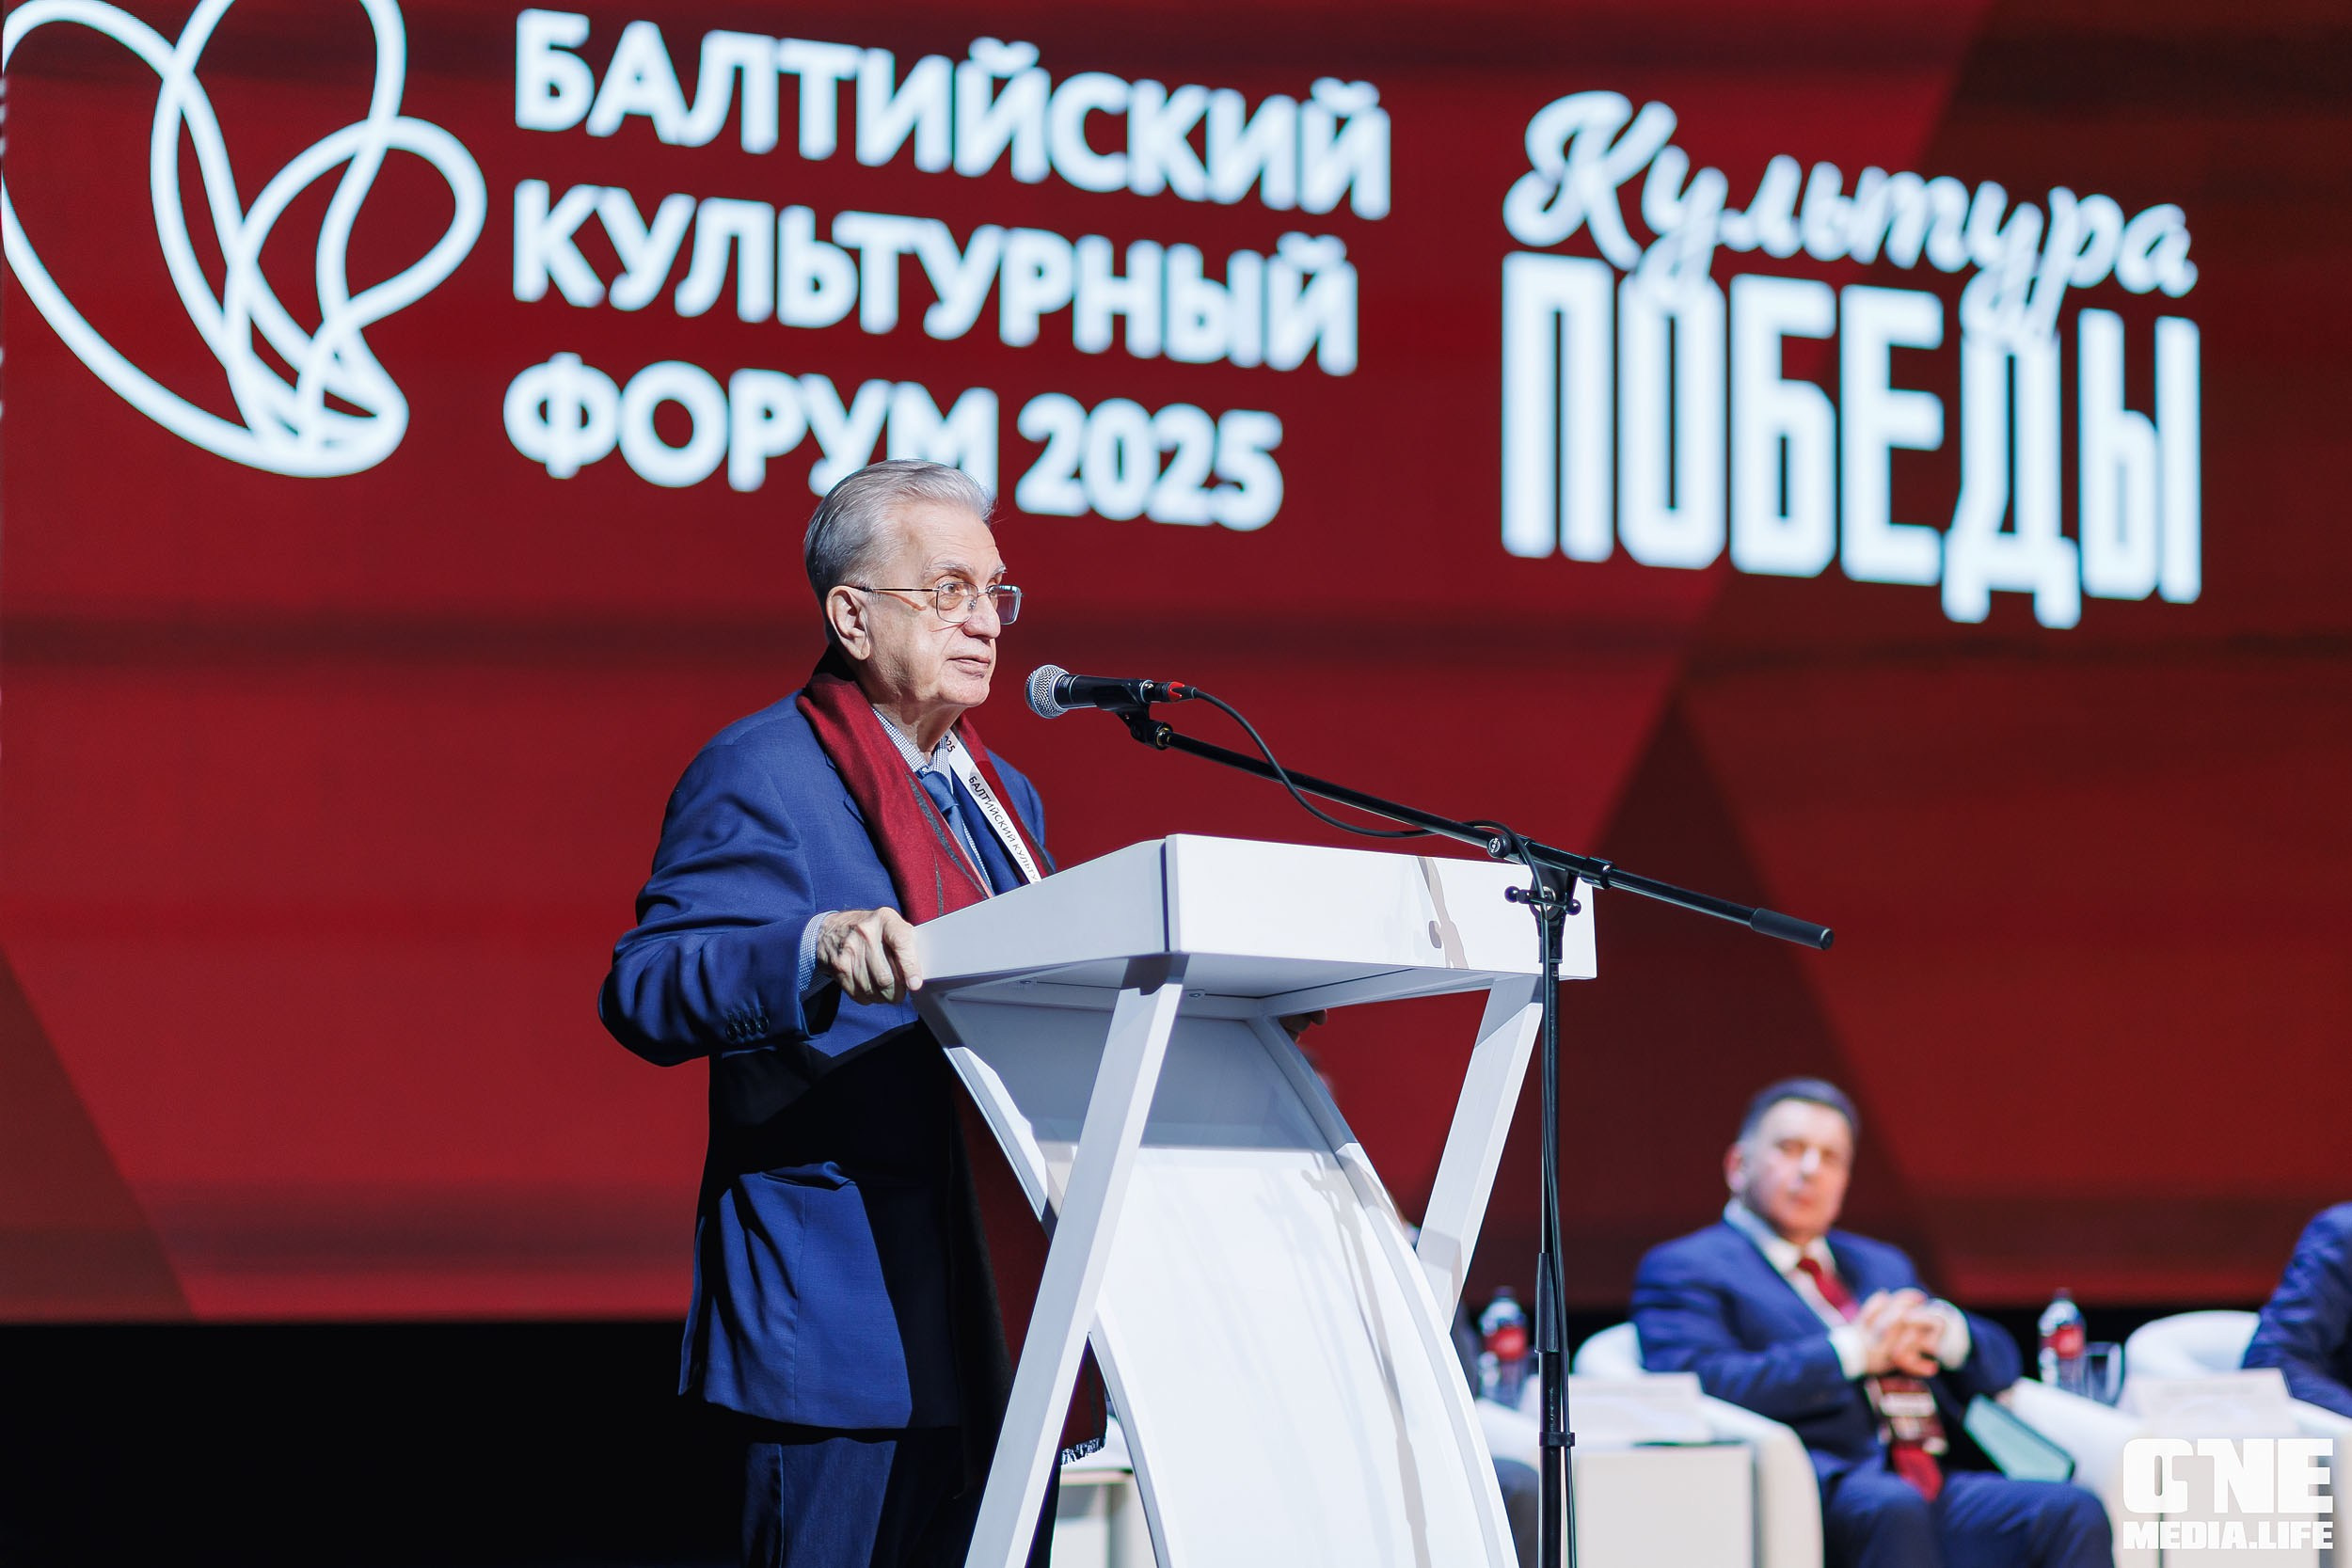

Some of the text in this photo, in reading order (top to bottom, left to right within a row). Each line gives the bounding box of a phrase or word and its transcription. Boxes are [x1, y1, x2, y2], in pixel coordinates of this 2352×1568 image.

[515, 8, 1391, 220] БАЛТИЙСКИЙ
[513, 179, 1358, 376] КУЛЬТУРНЫЙ
[1502, 90, 2200, 348] Культура
[502, 351, 1284, 531] ФОРУМ 2025
[1501, 250, 2202, 630] ПОБЕДЫ
[968, 775, 1016, 843] БАЛТИЙСКИЙ
